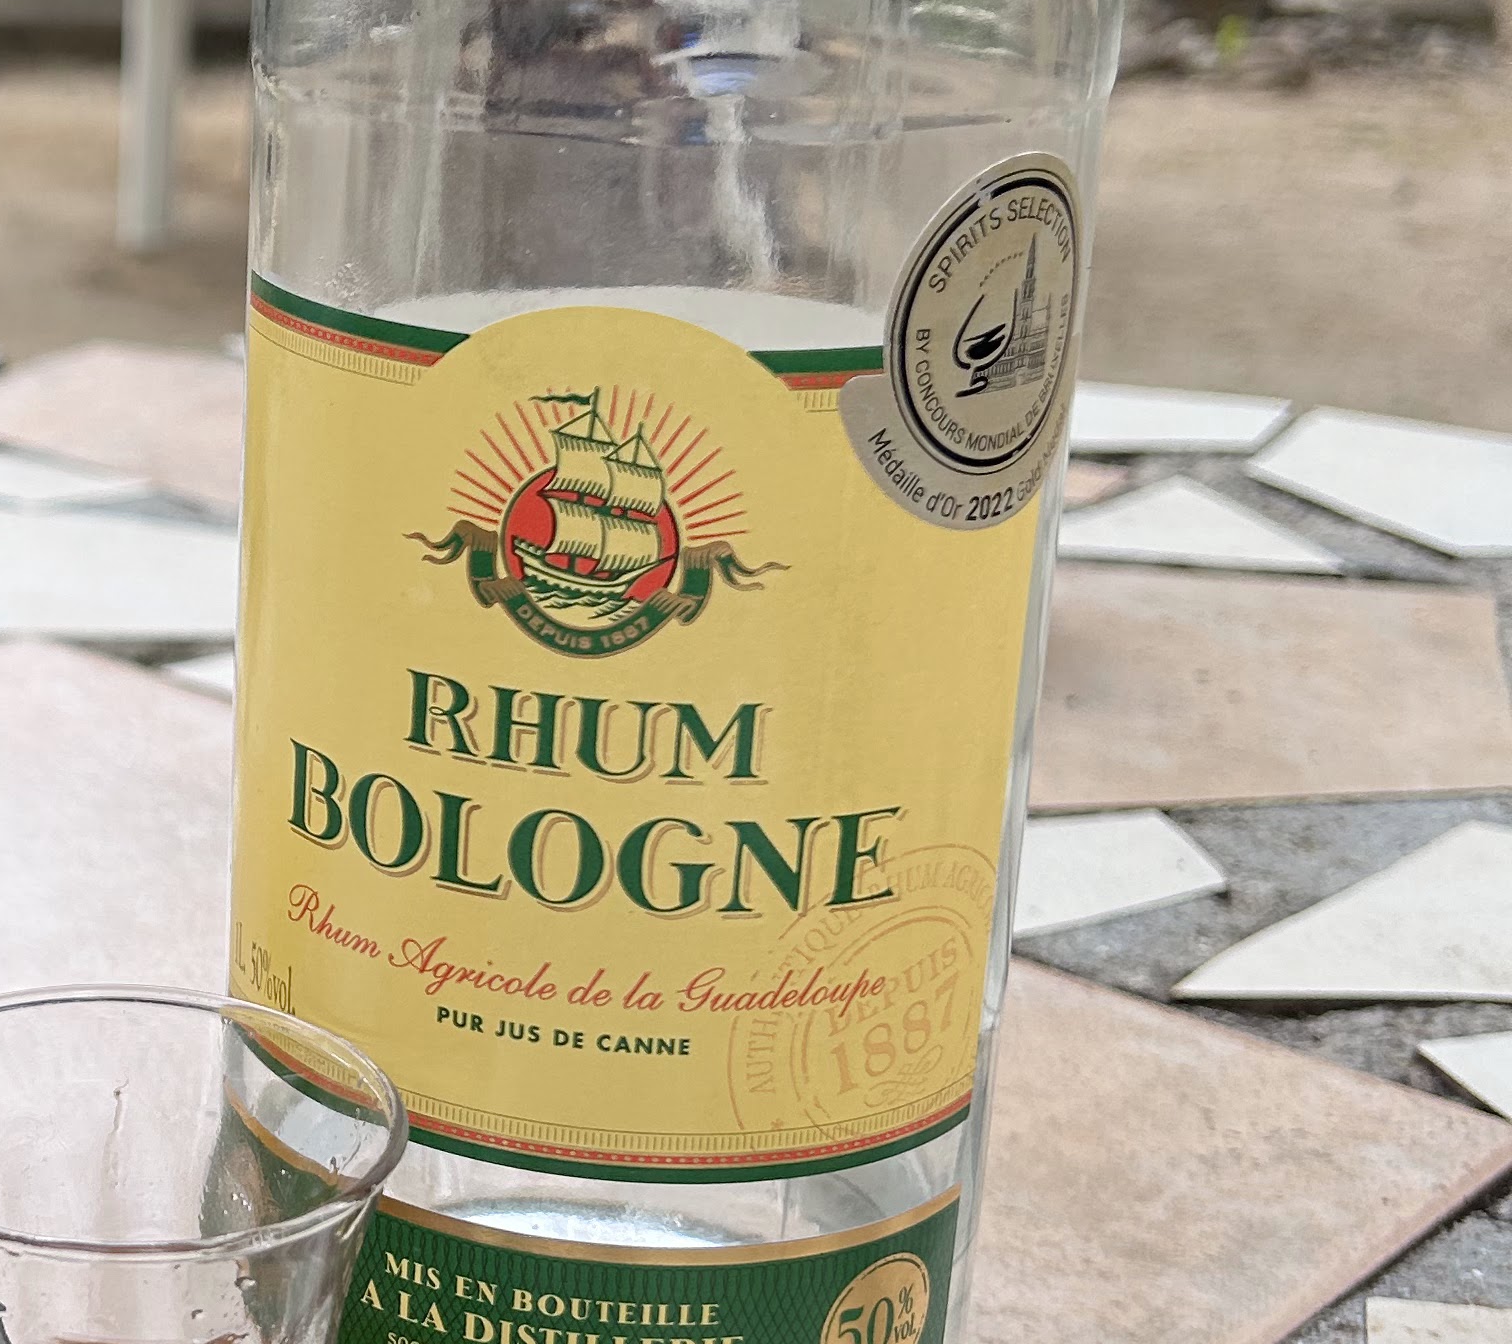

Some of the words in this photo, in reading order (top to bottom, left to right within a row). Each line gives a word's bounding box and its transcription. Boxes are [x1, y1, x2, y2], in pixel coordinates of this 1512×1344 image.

[928, 208, 1002, 293] SPIRITS
[1007, 196, 1071, 264] SELECTION
[916, 328, 931, 354] BY
[915, 360, 967, 445] CONCOURS
[965, 425, 1024, 452] MONDIAL
[1025, 406, 1039, 425] DE
[868, 428, 925, 503] Médaille
[926, 491, 963, 520] d'Or
[965, 486, 1013, 521] 2022
[515, 605, 592, 649] DEPUIS
[600, 616, 650, 649] 1887
[404, 668, 768, 784] RHUM
[288, 737, 904, 916] BOLOGNE
[287, 884, 382, 958] Rhum
[388, 936, 557, 996] Agricole
[567, 967, 612, 1007] de
[622, 970, 664, 1010] la
[677, 966, 887, 1018] Guadeloupe
[436, 1006, 485, 1034] PUR
[495, 1019, 541, 1044] JUS
[552, 1028, 585, 1049] DE
[595, 1033, 691, 1056] CANNE
[831, 970, 961, 1095] 1887
[360, 1278, 384, 1311] A
[398, 1290, 448, 1333] LA
[384, 1251, 441, 1290] MIS
[454, 1275, 498, 1306] EN
[512, 1288, 720, 1327] BOUTEILLE
